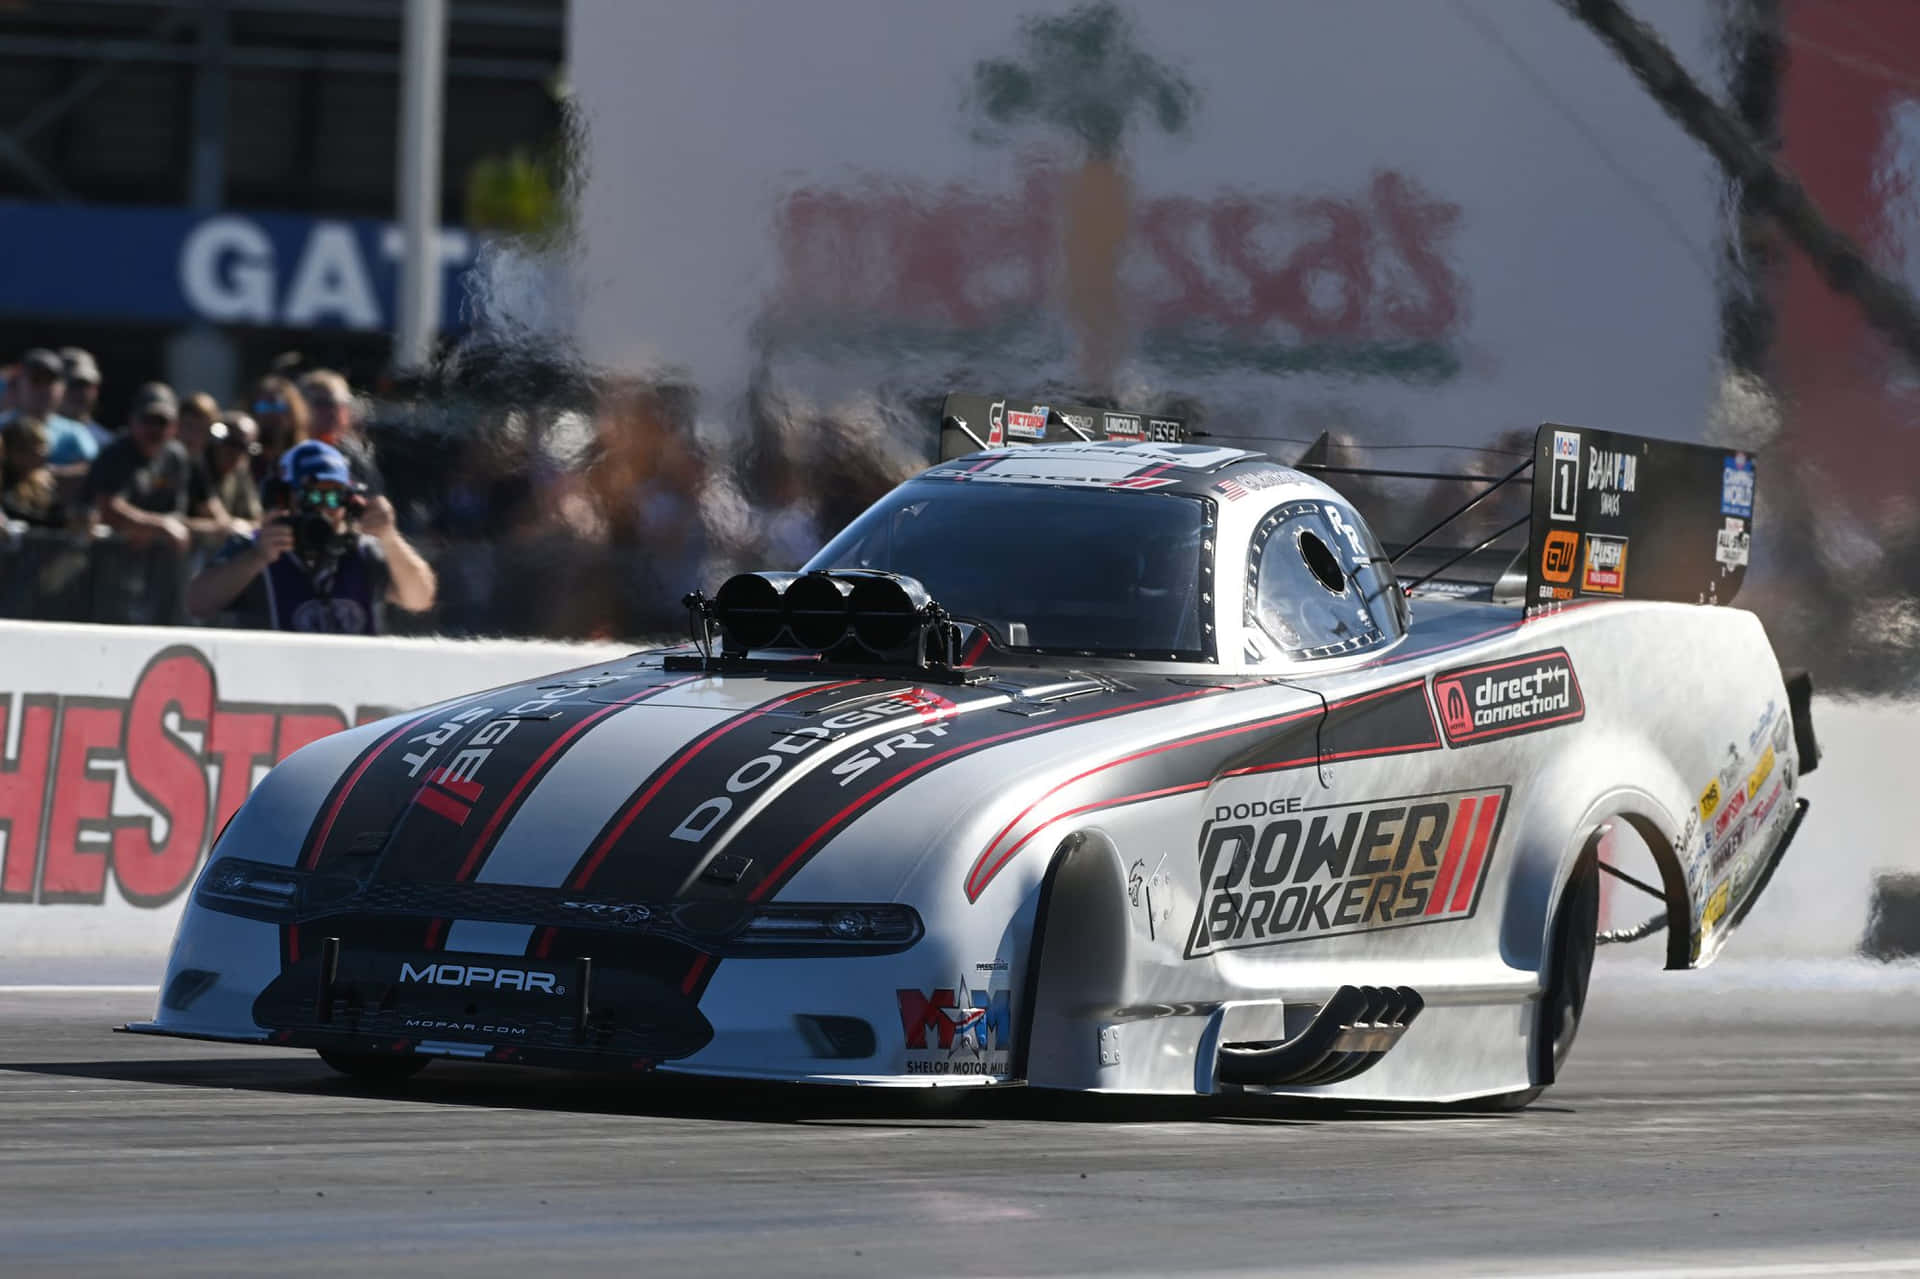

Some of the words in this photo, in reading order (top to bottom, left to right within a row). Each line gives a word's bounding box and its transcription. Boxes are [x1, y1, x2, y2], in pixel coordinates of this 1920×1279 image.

[1105, 416, 1139, 434] LINCOLN
[1556, 436, 1578, 457] Mobil
[1560, 463, 1570, 511] 1
[1475, 667, 1556, 706] direct
[1475, 690, 1568, 726] connection
[401, 705, 494, 778] SRT
[831, 722, 949, 786] SRT
[670, 696, 920, 842] DODGE
[1215, 798, 1302, 822] DODGE
[1213, 802, 1449, 890] POWER
[1208, 871, 1437, 942] BROKERS
[405, 1019, 527, 1036] MOPAR.COM
[907, 1060, 951, 1074] SHELOR
[953, 1061, 988, 1075] MOTOR
[990, 1062, 1009, 1075] MILE
